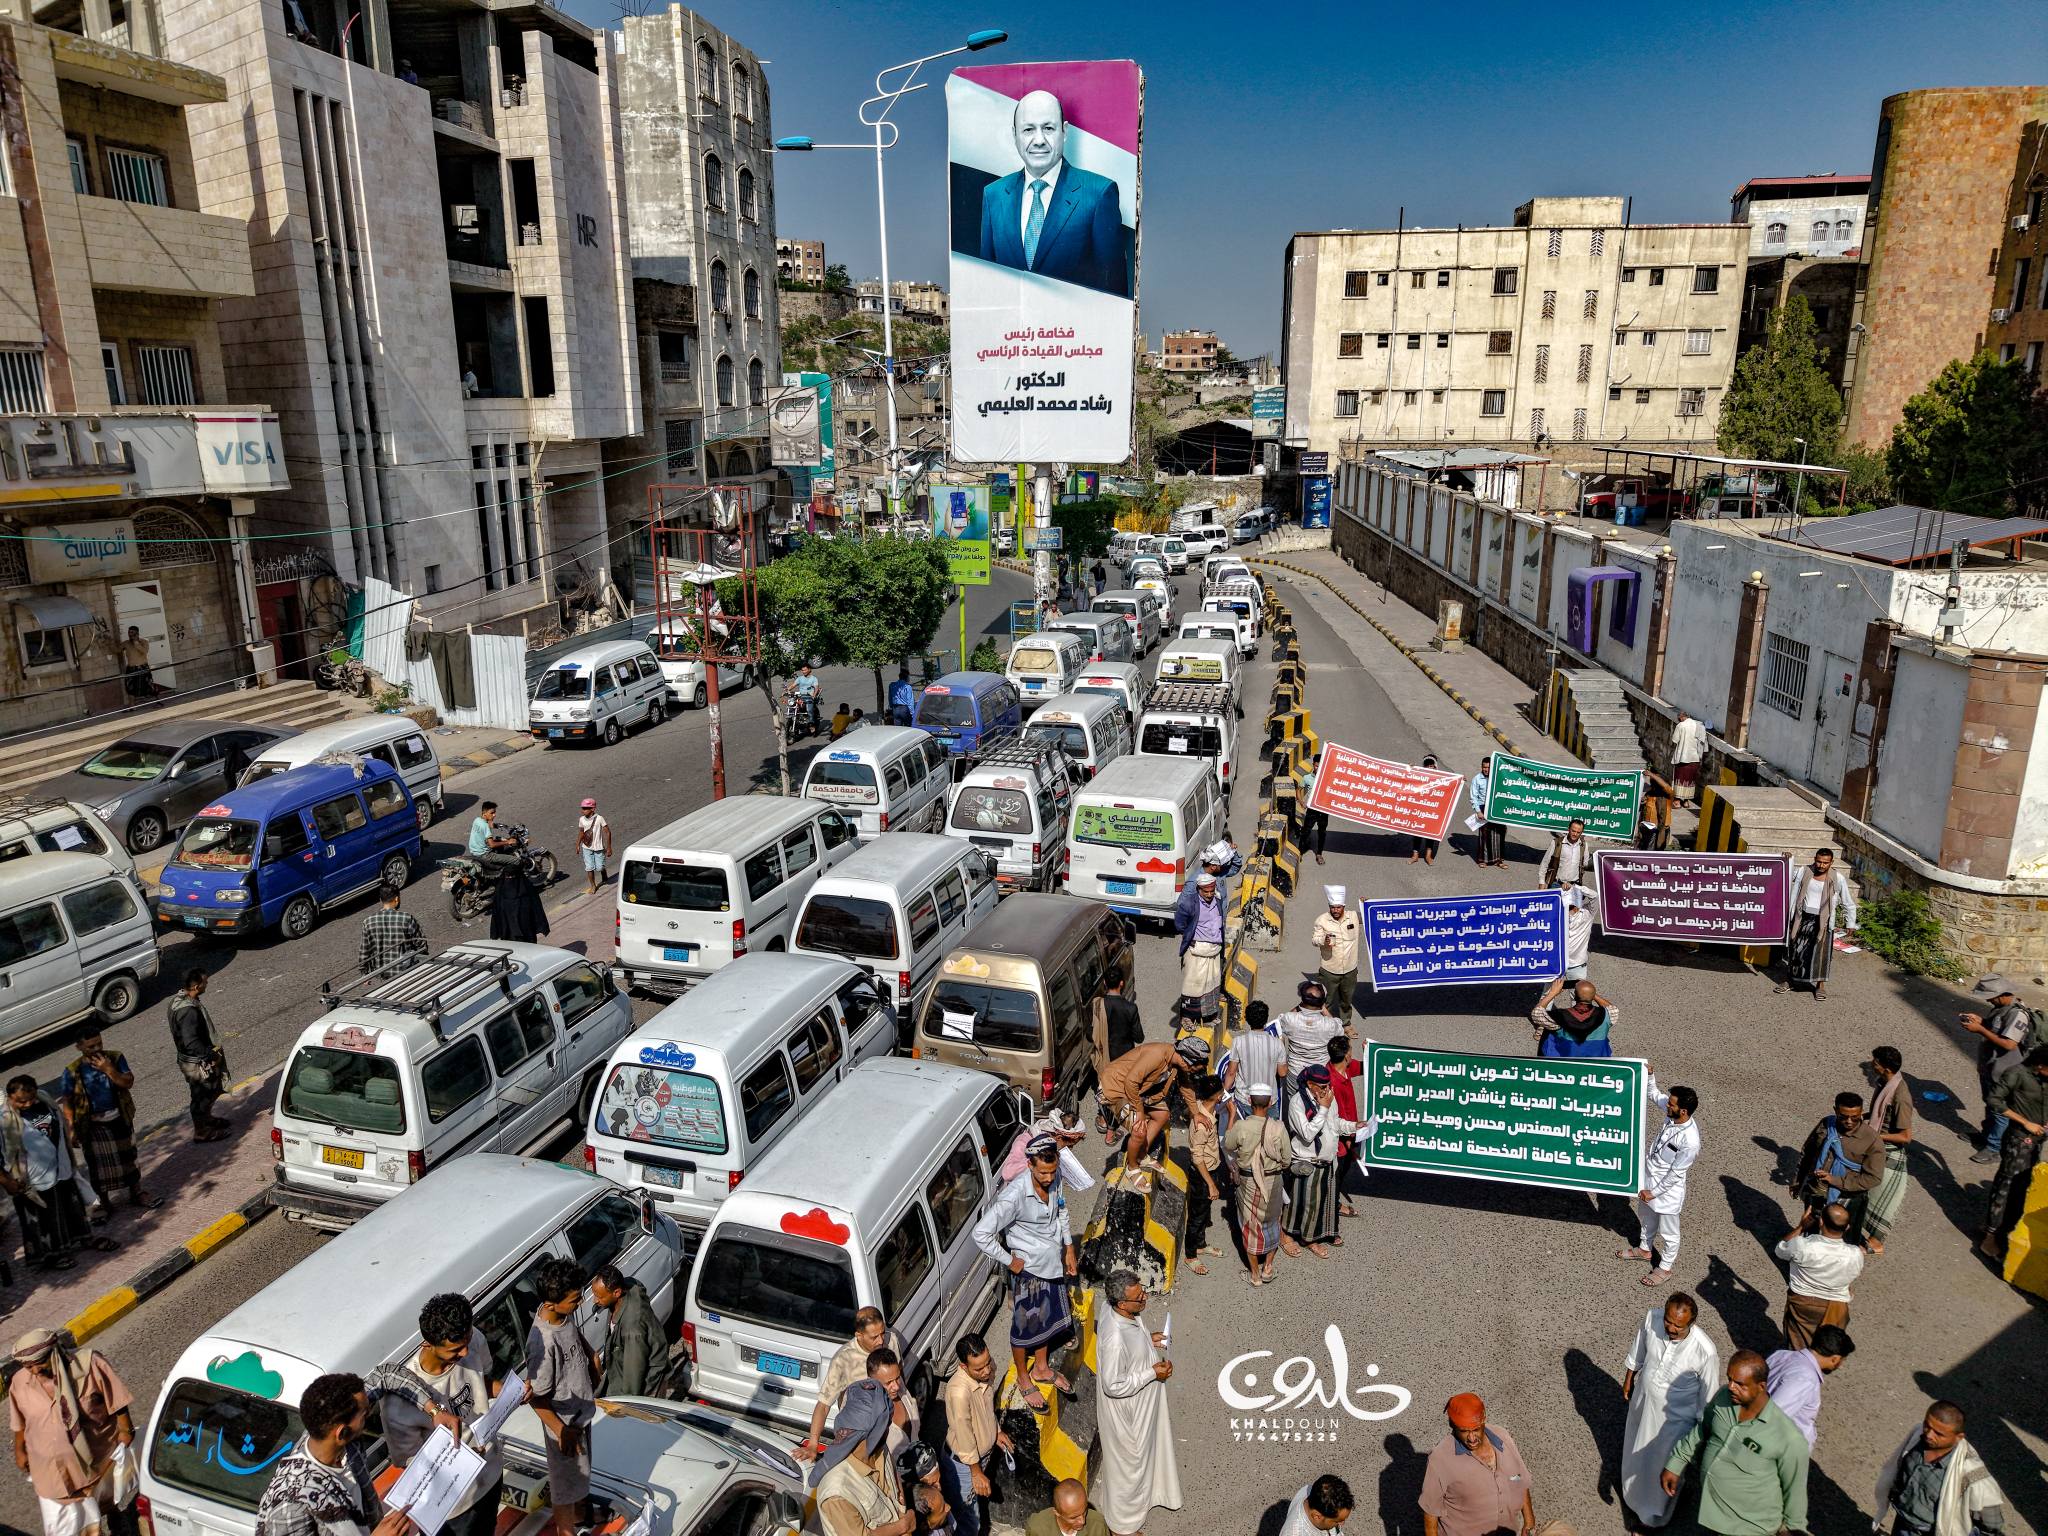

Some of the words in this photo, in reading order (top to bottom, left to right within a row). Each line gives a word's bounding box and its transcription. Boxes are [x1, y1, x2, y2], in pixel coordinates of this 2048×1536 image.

[1004, 326, 1034, 342] رئيس
[1037, 327, 1075, 339] فخامة
[976, 345, 1020, 362] الرئاسي
[1021, 345, 1063, 360] القيادة
[1064, 345, 1103, 359] مجلس
[1016, 371, 1065, 391] الدكتور
[977, 396, 1034, 418] العليمي
[1036, 399, 1077, 411] محمد
[1080, 395, 1112, 415] رشاد
[213, 440, 276, 465] VISA
[1336, 752, 1357, 764] اليمنية
[1358, 759, 1380, 770] الشركة
[1334, 765, 1346, 775] تعز
[1347, 768, 1361, 778] حصة
[1381, 767, 1406, 779] يطالبون
[1538, 769, 1561, 781] المدينة
[1332, 777, 1349, 787] سبع
[1362, 773, 1382, 784] ترحيل
[1383, 777, 1402, 790] بسرعة
[1406, 772, 1430, 782] الباصات
[1502, 776, 1530, 789] يناشدون
[1560, 774, 1588, 784] مديريات
[1589, 776, 1599, 785] في
[1600, 777, 1615, 785] الغاز
[1616, 778, 1634, 788] وكلاء
[813, 785, 839, 793] الحكمة
[840, 786, 864, 794] جامعة
[1350, 782, 1370, 795] بواقع
[1370, 787, 1396, 799] الشركة
[1558, 784, 1577, 794] محطة
[1578, 788, 1589, 796] عبر
[1355, 795, 1376, 807] المحضر
[1396, 793, 1407, 802] من
[1408, 795, 1439, 808] المعتمدة
[1495, 791, 1521, 801] حصتهم
[1522, 794, 1543, 803] ترحيل
[1612, 792, 1627, 801] التي
[1376, 800, 1393, 810] حسب
[1543, 797, 1564, 809] بسرعة
[1564, 801, 1591, 811] التنفيذي
[1592, 804, 1609, 813] العام
[1366, 810, 1391, 822] الوزراء
[1411, 807, 1439, 820] مقطورات
[1503, 806, 1536, 817] المواطنين
[1536, 812, 1547, 820] عن
[1610, 806, 1631, 815] المدير
[1390, 816, 1411, 828] رئيس
[1411, 819, 1425, 829] من
[1593, 817, 1608, 826] الغاز
[1609, 819, 1620, 828] من
[1613, 861, 1649, 872] محافظ
[1650, 863, 1690, 876] يحملوا
[1692, 863, 1732, 875] الباصات
[1736, 866, 1773, 880] سائقي
[1622, 878, 1667, 892] شمسان
[1669, 881, 1694, 893] نبيل
[1696, 881, 1719, 895] تعز
[1721, 883, 1766, 894] محافظة
[1621, 897, 1639, 908] من
[1642, 897, 1690, 909] المحافظة
[1693, 900, 1720, 910] حصة
[1723, 900, 1765, 915] بمتابعة
[1376, 910, 1412, 923] المدينة
[1414, 909, 1458, 922] مديريات
[1460, 905, 1476, 922] في
[1479, 904, 1516, 916] الباصات
[1520, 902, 1553, 918] سائقي
[1498, 918, 1551, 934] يناشدون
[1631, 913, 1655, 926] صافر
[1657, 915, 1673, 926] من
[1675, 916, 1728, 931] وترحيلها
[1730, 918, 1754, 931] الغاز
[1380, 926, 1414, 940] القيادة
[1417, 926, 1454, 939] مجلس
[1457, 923, 1494, 936] رئيس
[1426, 943, 1455, 956] صرف
[1458, 939, 1510, 954] الحكومة
[1512, 939, 1554, 951] ورئيس
[1378, 945, 1424, 960] حصتهم
[1381, 960, 1423, 976] الشركة
[1426, 961, 1441, 974] من
[1444, 958, 1495, 970] المعتمدة
[1497, 957, 1525, 970] الغاز
[1528, 958, 1549, 970] من
[1383, 1058, 1403, 1078] في
[1406, 1059, 1466, 1078] السيارات
[1469, 1064, 1519, 1082] تموين
[1521, 1067, 1575, 1084] محطات
[1579, 1072, 1624, 1094] وكلاء
[1379, 1084, 1413, 1098] العام
[1416, 1088, 1454, 1103] المدير
[1458, 1087, 1506, 1106] يناشدن
[1509, 1092, 1557, 1111] المدينة
[1560, 1097, 1622, 1118] مديريات
[1375, 1107, 1420, 1126] بترحيل
[1464, 1115, 1506, 1131] محسن
[1507, 1119, 1571, 1138] المهندس
[284, 1137, 300, 1146] DAMAS
[1379, 1131, 1404, 1149] تعز
[1571, 1125, 1629, 1147] التنفيذي
[1407, 1134, 1463, 1153] لمحافظة
[1466, 1140, 1528, 1160] المخصصة
[598, 1156, 615, 1165] DAMAS
[1531, 1146, 1571, 1164] كاملة
[1575, 1150, 1622, 1171] الحصة
[699, 1336, 720, 1347] DAMAS
[162, 1407, 203, 1455] الله
